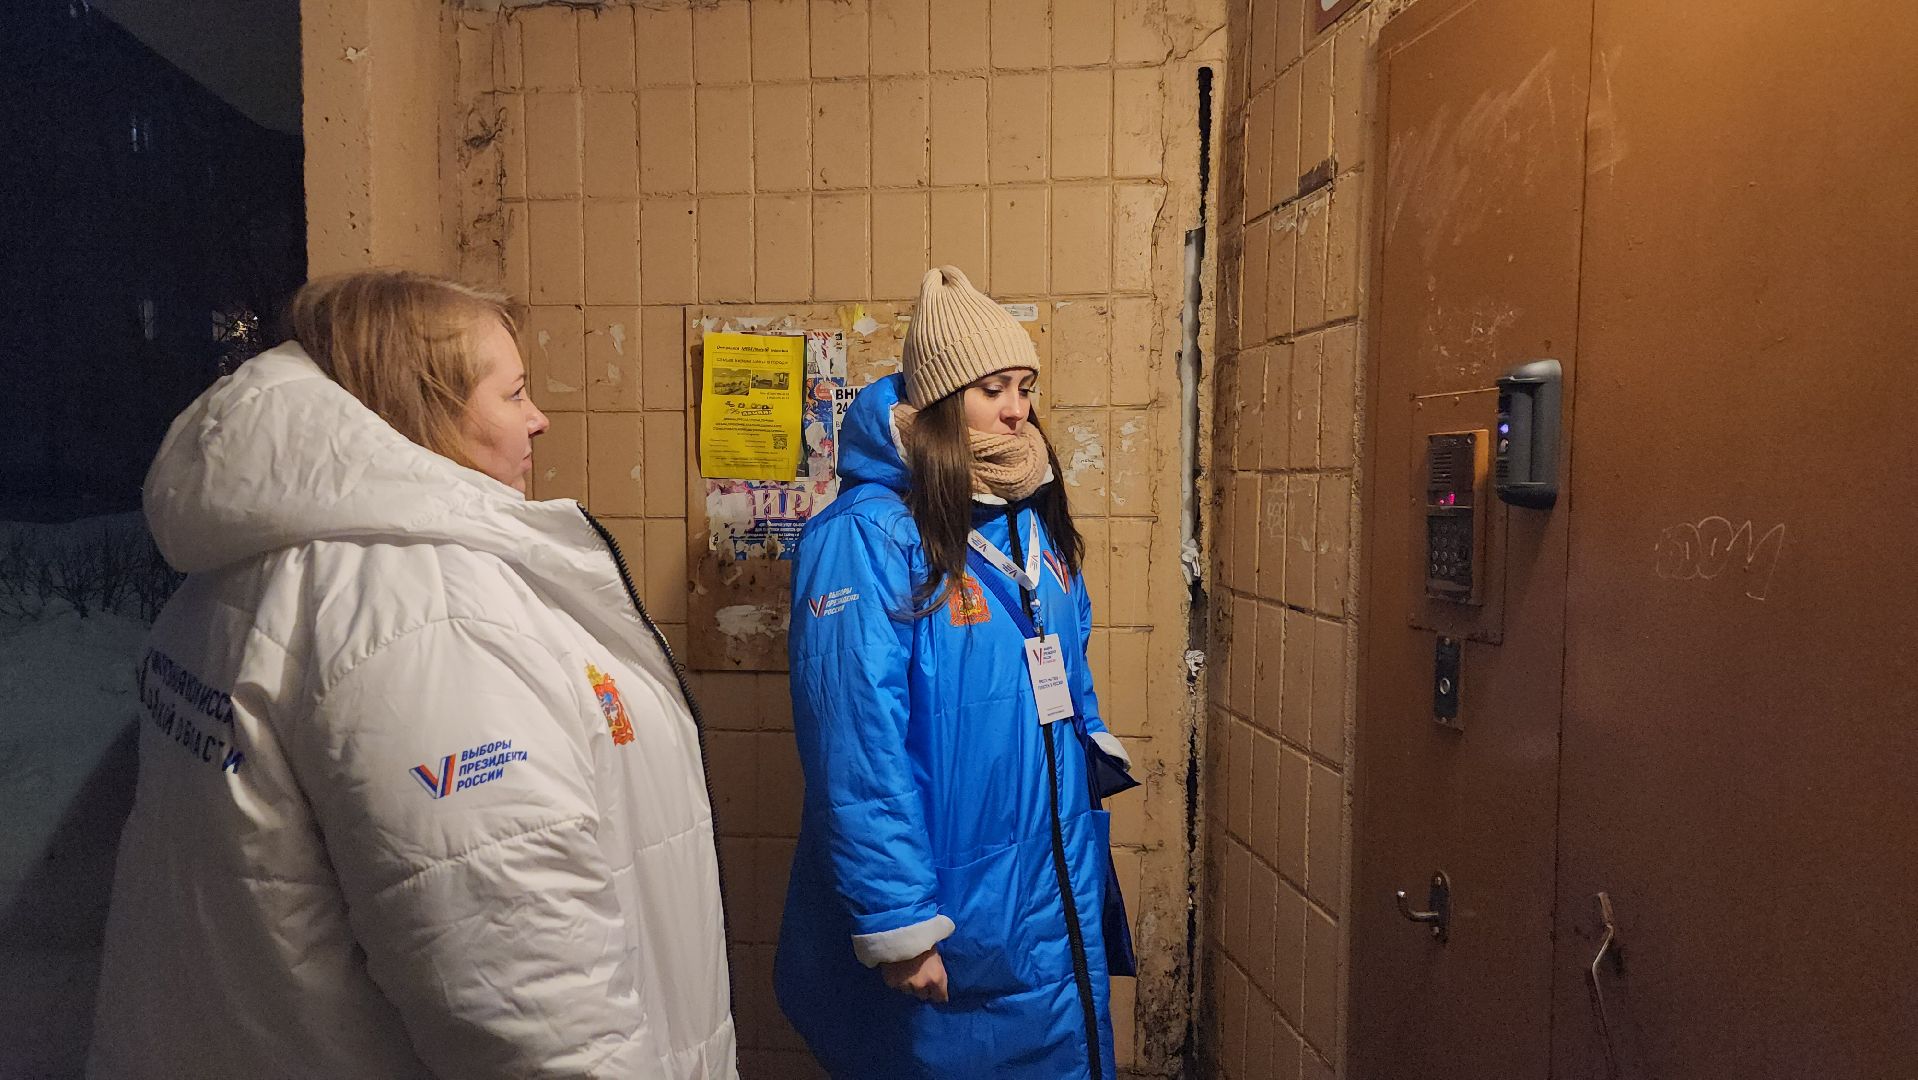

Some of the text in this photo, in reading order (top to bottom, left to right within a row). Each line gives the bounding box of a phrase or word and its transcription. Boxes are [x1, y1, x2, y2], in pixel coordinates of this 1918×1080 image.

[458, 750, 528, 777] ПРЕЗИДЕНТА
[460, 739, 512, 763] ВЫБОРЫ
[456, 767, 504, 792] РОССИИ
